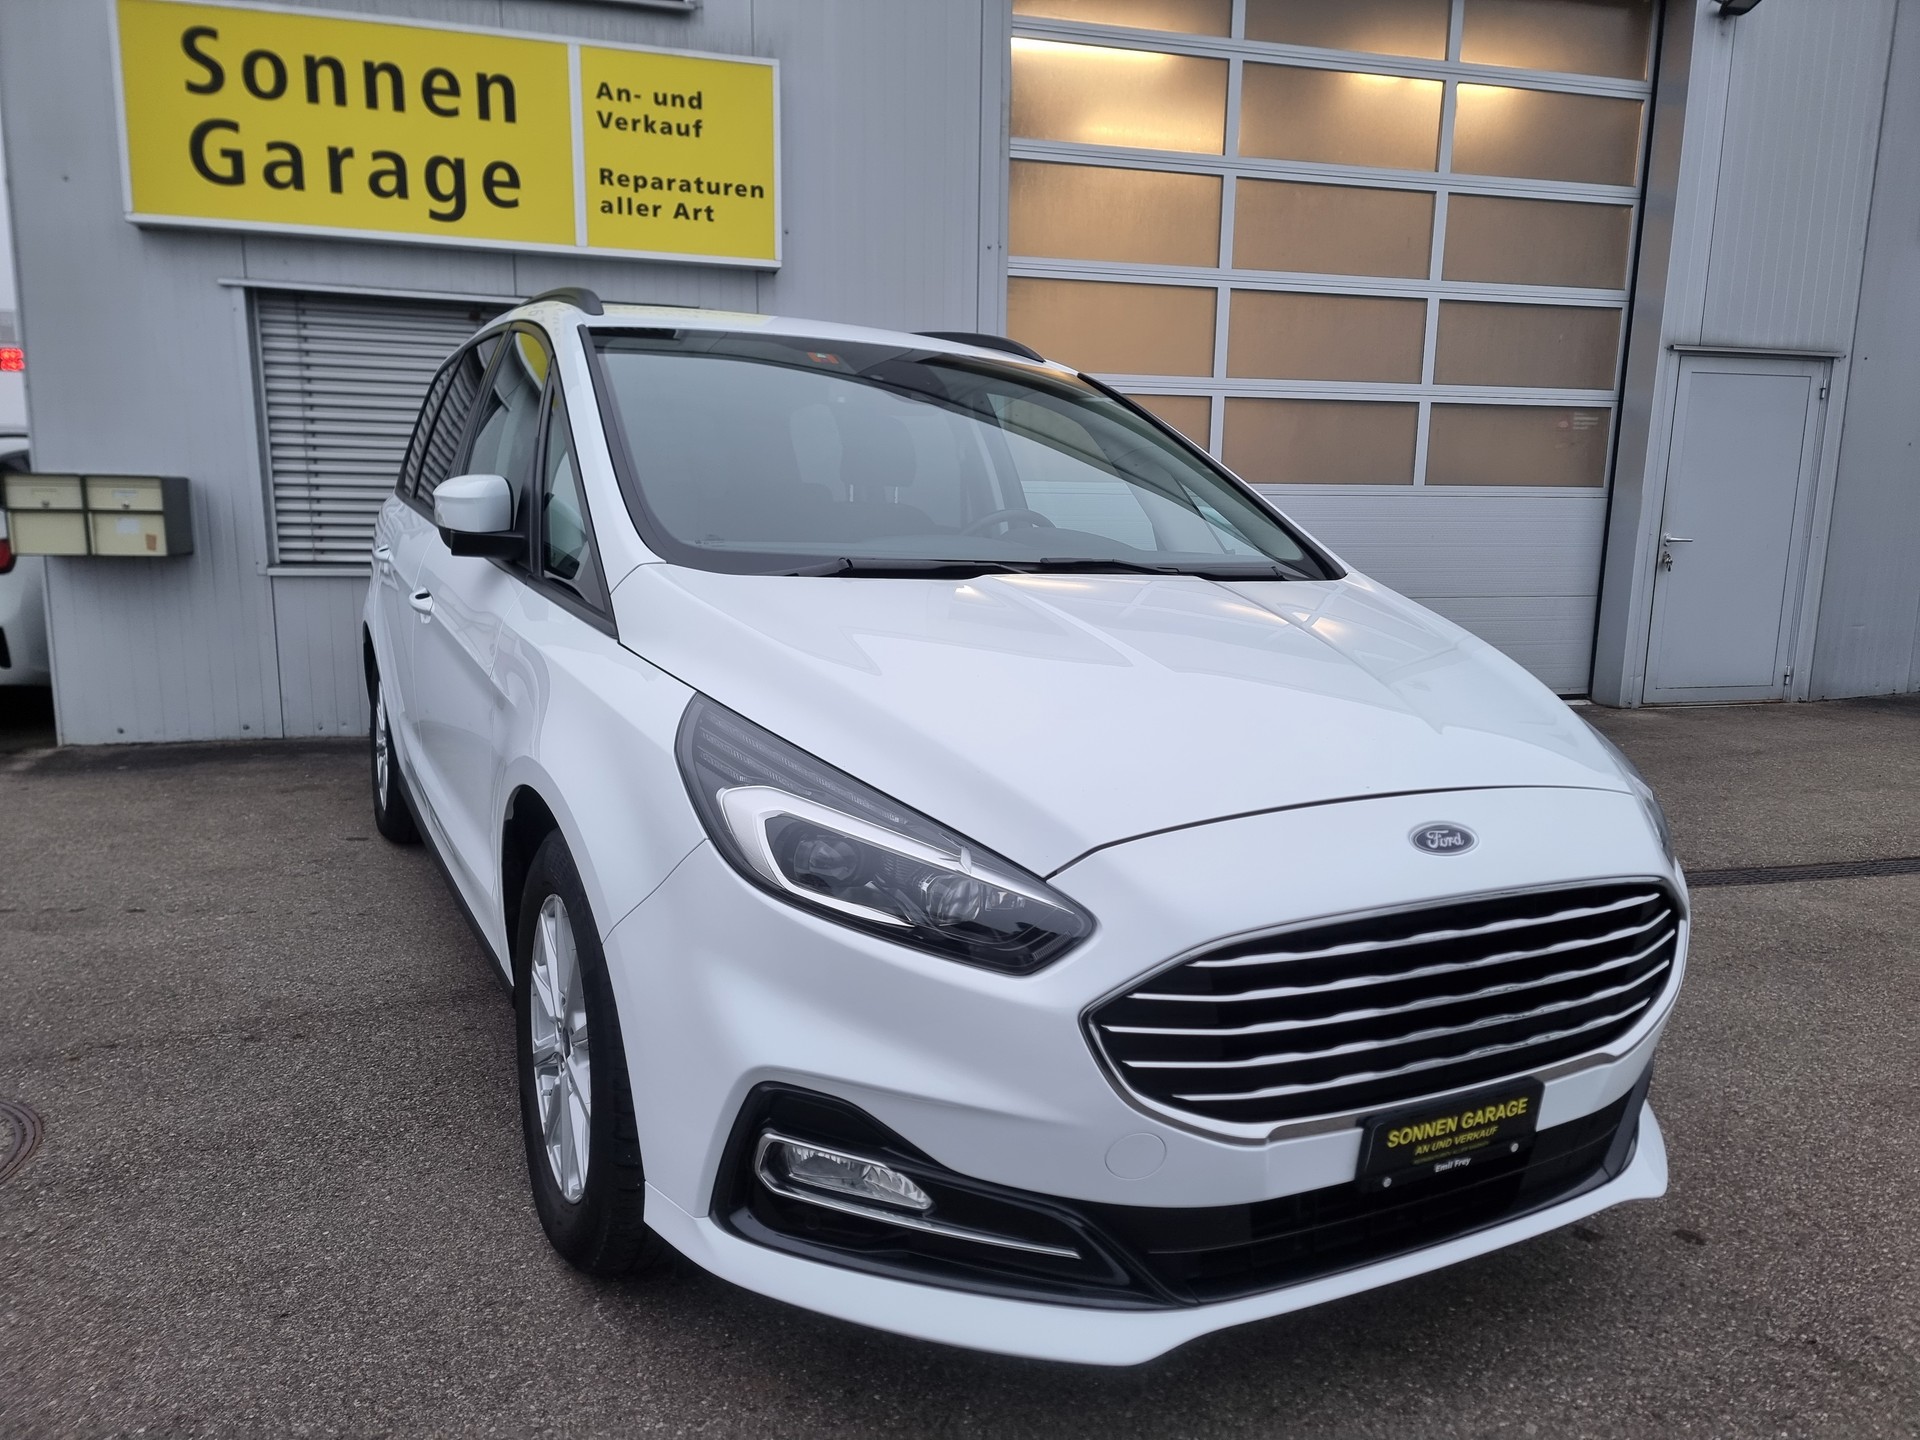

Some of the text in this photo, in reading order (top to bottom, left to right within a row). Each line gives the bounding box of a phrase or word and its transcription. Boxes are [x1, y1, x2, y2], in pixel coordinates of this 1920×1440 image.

[180, 25, 517, 124] Sonnen
[596, 81, 703, 110] An- und
[596, 110, 703, 138] Verkauf
[188, 118, 522, 223] Garage
[599, 167, 764, 199] Reparaturen
[600, 196, 715, 223] aller Art
[1427, 830, 1464, 848] Ford
[1387, 1098, 1529, 1148] SONNEN GARAGE
[1415, 1144, 1431, 1156] AN
[1432, 1138, 1453, 1152] UND
[1454, 1126, 1499, 1145] VERKAUF
[1435, 1158, 1472, 1173] Emil Frey
